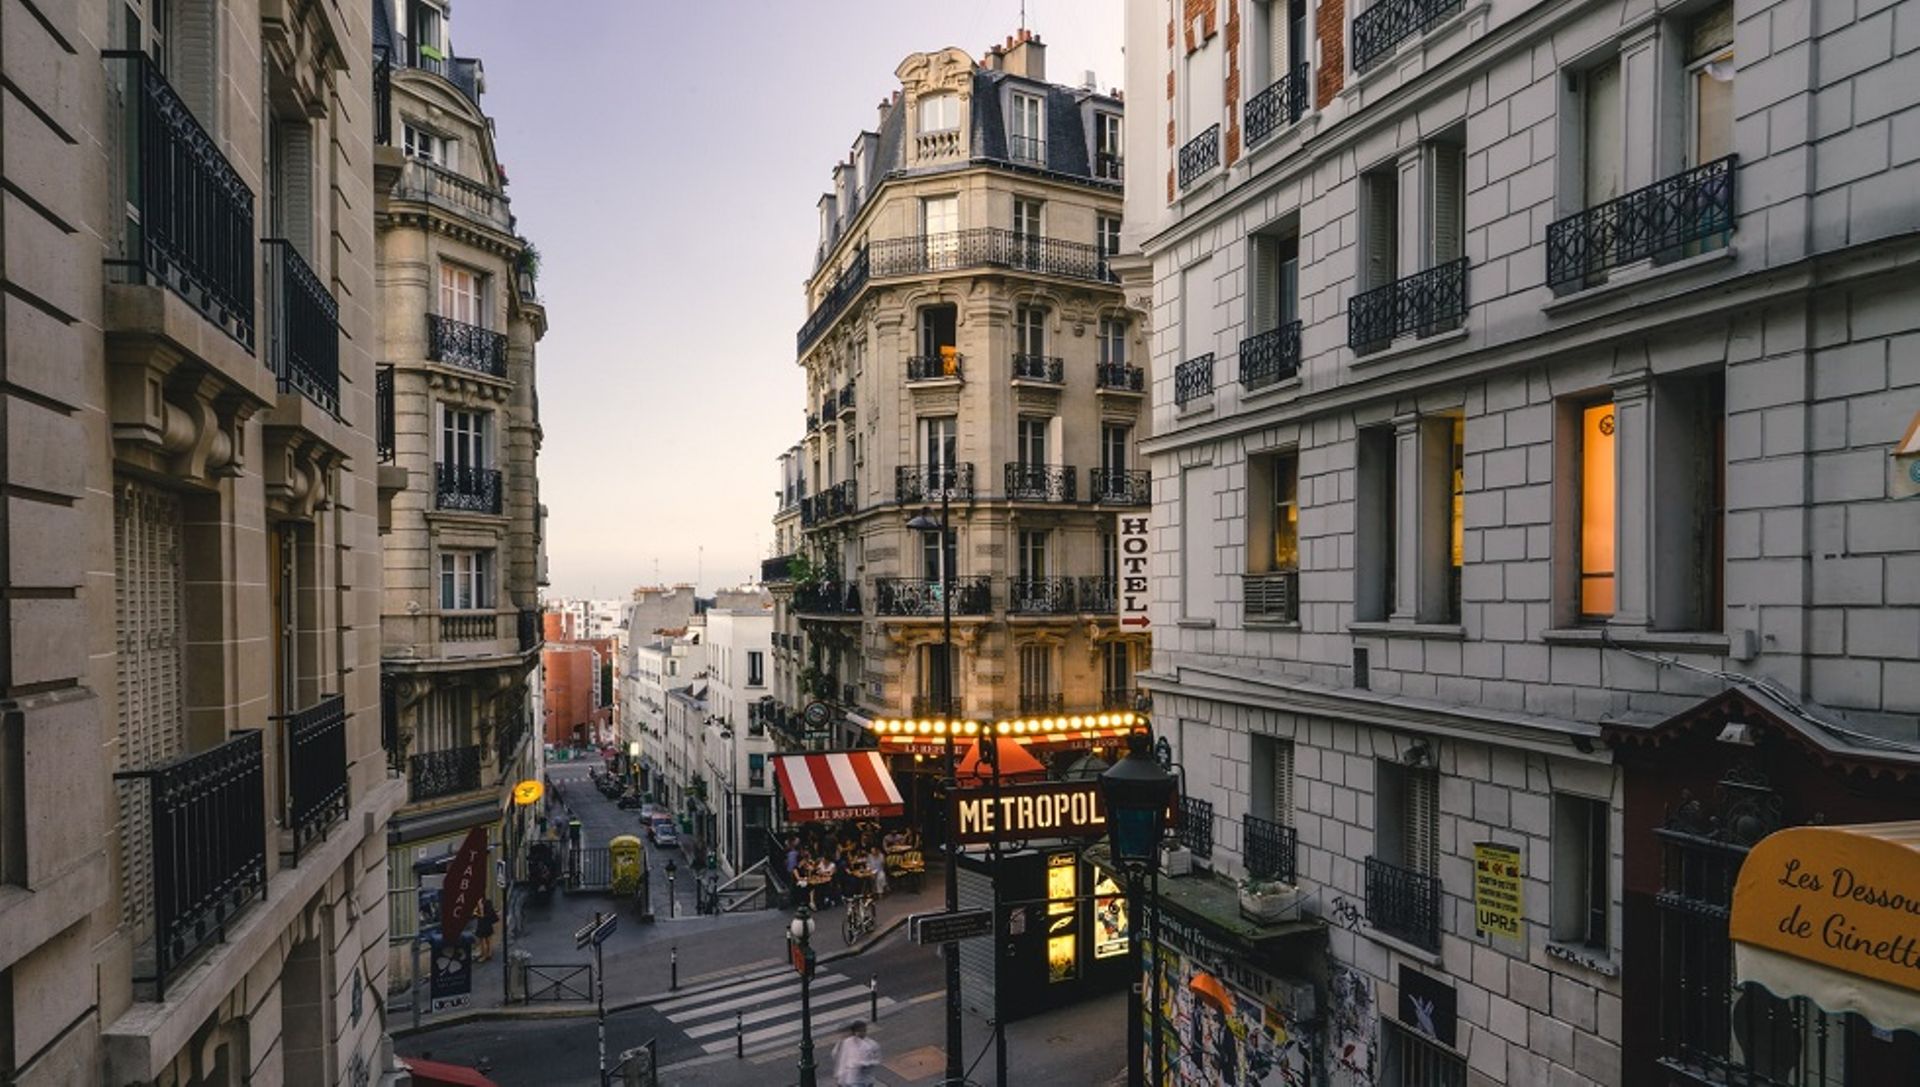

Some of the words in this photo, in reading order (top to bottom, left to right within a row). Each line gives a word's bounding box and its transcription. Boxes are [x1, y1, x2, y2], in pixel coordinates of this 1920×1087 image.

[1122, 518, 1148, 612] HOTEL
[920, 744, 962, 754] REFUE
[814, 810, 830, 820] LE
[832, 806, 880, 819] REFUGE
[959, 791, 1105, 834] METROPOL
[452, 849, 478, 919] TABAC
[1778, 859, 1824, 891] Les
[1779, 904, 1812, 938] de
